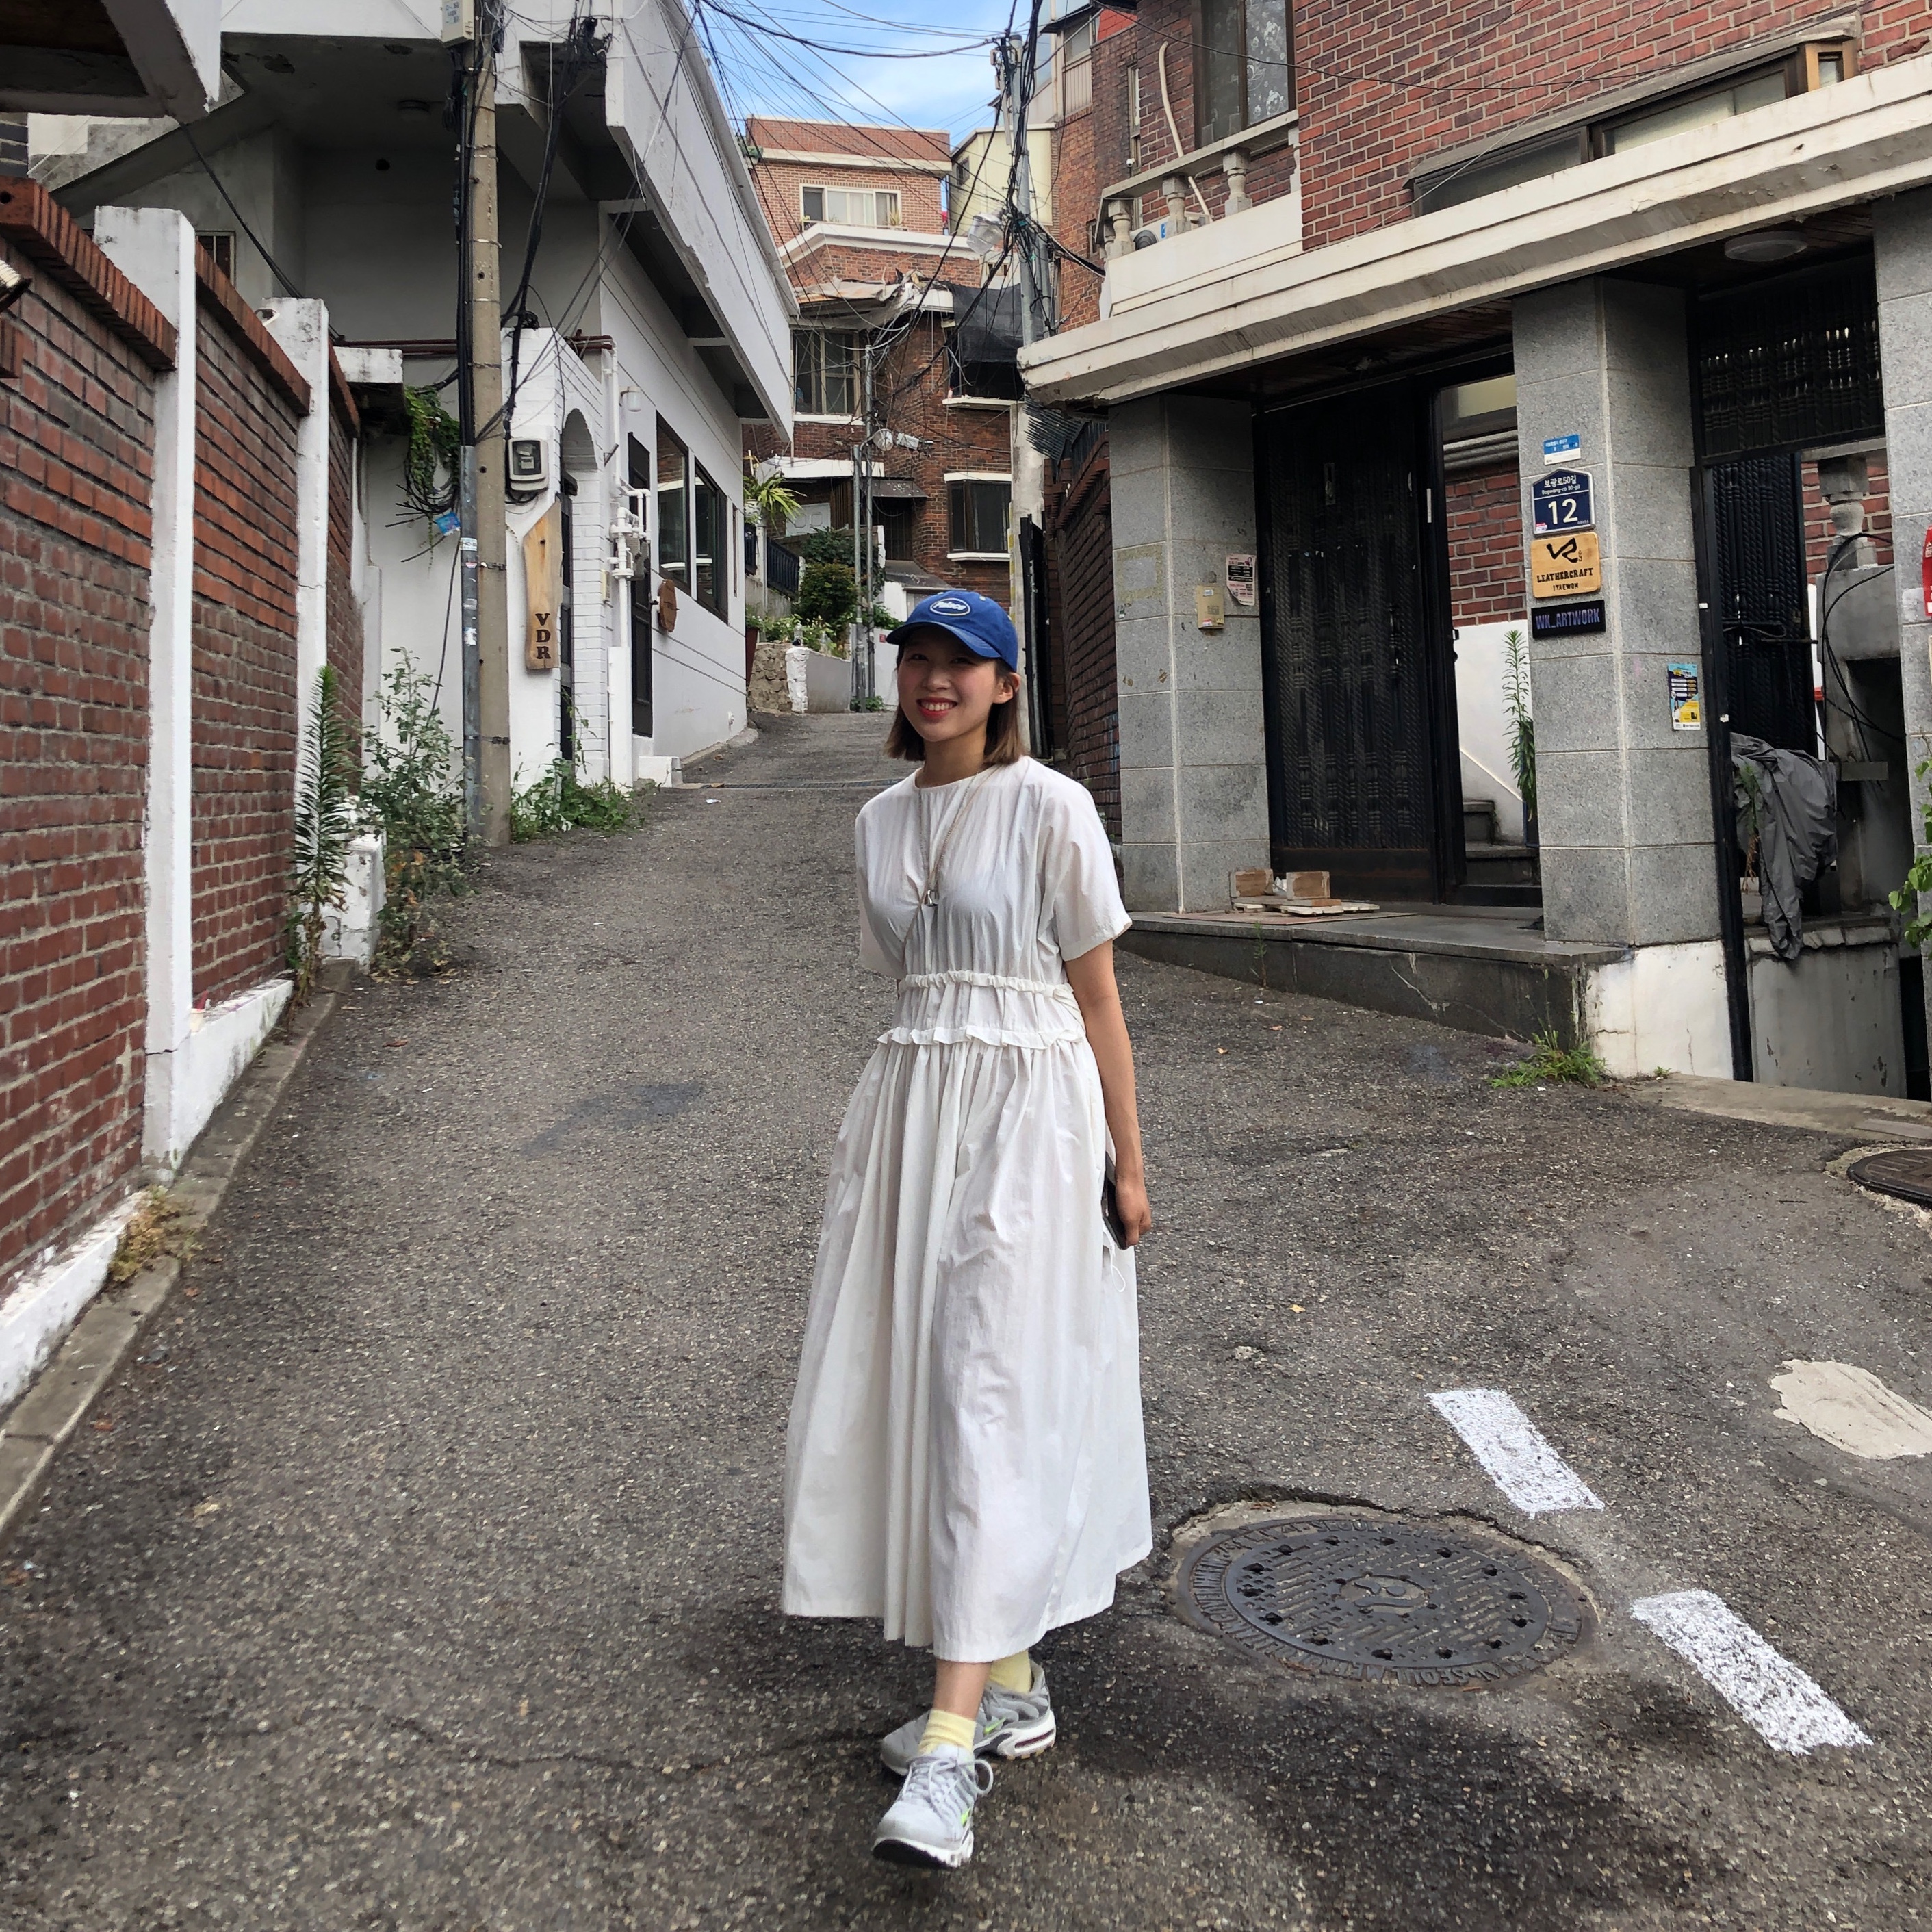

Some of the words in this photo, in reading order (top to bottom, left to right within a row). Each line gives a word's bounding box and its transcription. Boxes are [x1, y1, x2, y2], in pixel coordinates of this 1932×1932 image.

[1544, 475, 1577, 488] 보광로50길
[1548, 498, 1578, 525] 12
[1536, 567, 1594, 583] LEATHERCRAFT
[1553, 582, 1579, 591] ITAEWON
[535, 613, 551, 659] VDR
